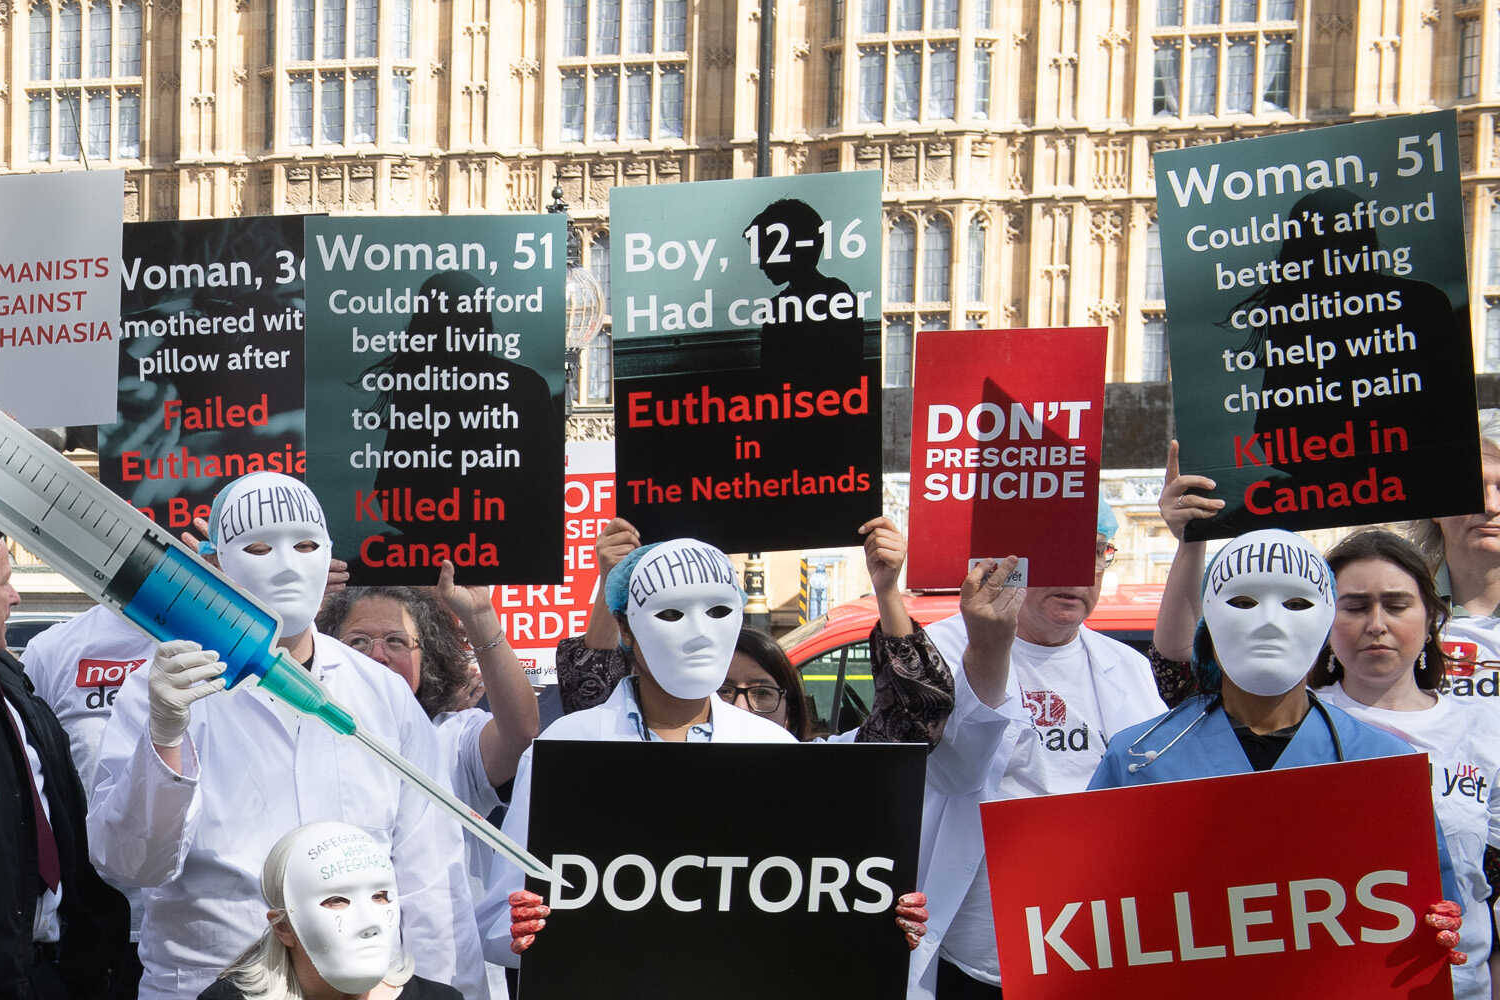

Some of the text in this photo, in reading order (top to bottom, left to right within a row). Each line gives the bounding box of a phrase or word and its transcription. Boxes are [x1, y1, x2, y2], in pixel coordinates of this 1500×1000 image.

[1167, 131, 1446, 208] Woman, 51
[1186, 193, 1436, 253] Couldn't afford
[315, 232, 554, 275] Woman, 51
[624, 219, 867, 281] Boy, 12-16
[1215, 242, 1413, 290] better living
[328, 285, 543, 315] Couldn't afford
[626, 289, 873, 332] Had cancer
[1230, 290, 1402, 330] conditions
[139, 346, 290, 380] pillow after
[352, 327, 521, 358] better living
[1222, 325, 1417, 371] to help with
[362, 365, 509, 391] conditions
[1223, 370, 1422, 414] chronic pain
[163, 394, 268, 430] Failed
[352, 403, 519, 437] to help with
[627, 376, 869, 428] Euthanised
[926, 401, 1091, 443] DON'T
[350, 443, 520, 476] chronic pain
[735, 435, 761, 460] in
[926, 446, 1086, 468] PRESCRIBE
[1234, 420, 1409, 470] Killed in
[355, 488, 505, 522] Killed in
[627, 466, 870, 504] The Netherlands
[924, 471, 1085, 501] SUICIDE
[1243, 468, 1407, 518] Canada
[359, 535, 500, 567] Canada
[549, 854, 895, 914] DOCTORS
[1025, 869, 1417, 976] KILLERS
